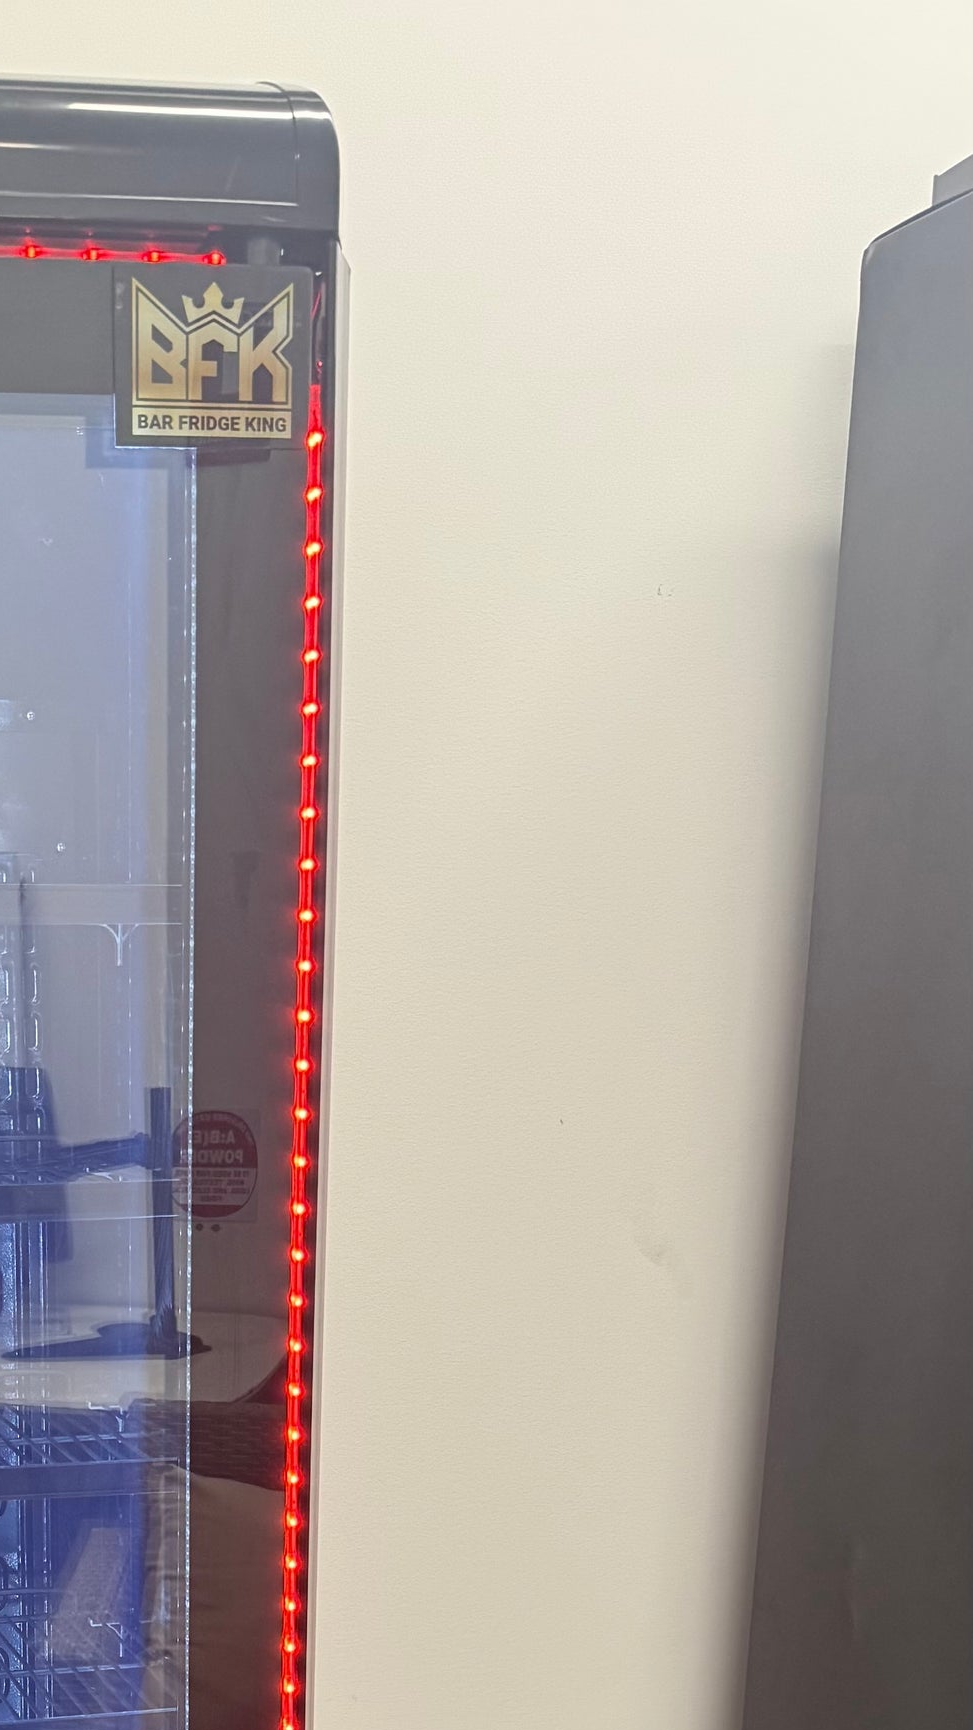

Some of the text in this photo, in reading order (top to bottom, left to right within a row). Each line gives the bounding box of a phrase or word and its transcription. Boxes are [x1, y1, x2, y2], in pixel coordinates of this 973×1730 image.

[135, 288, 289, 402] BFK
[137, 414, 287, 433] BAR FRIDGE KING
